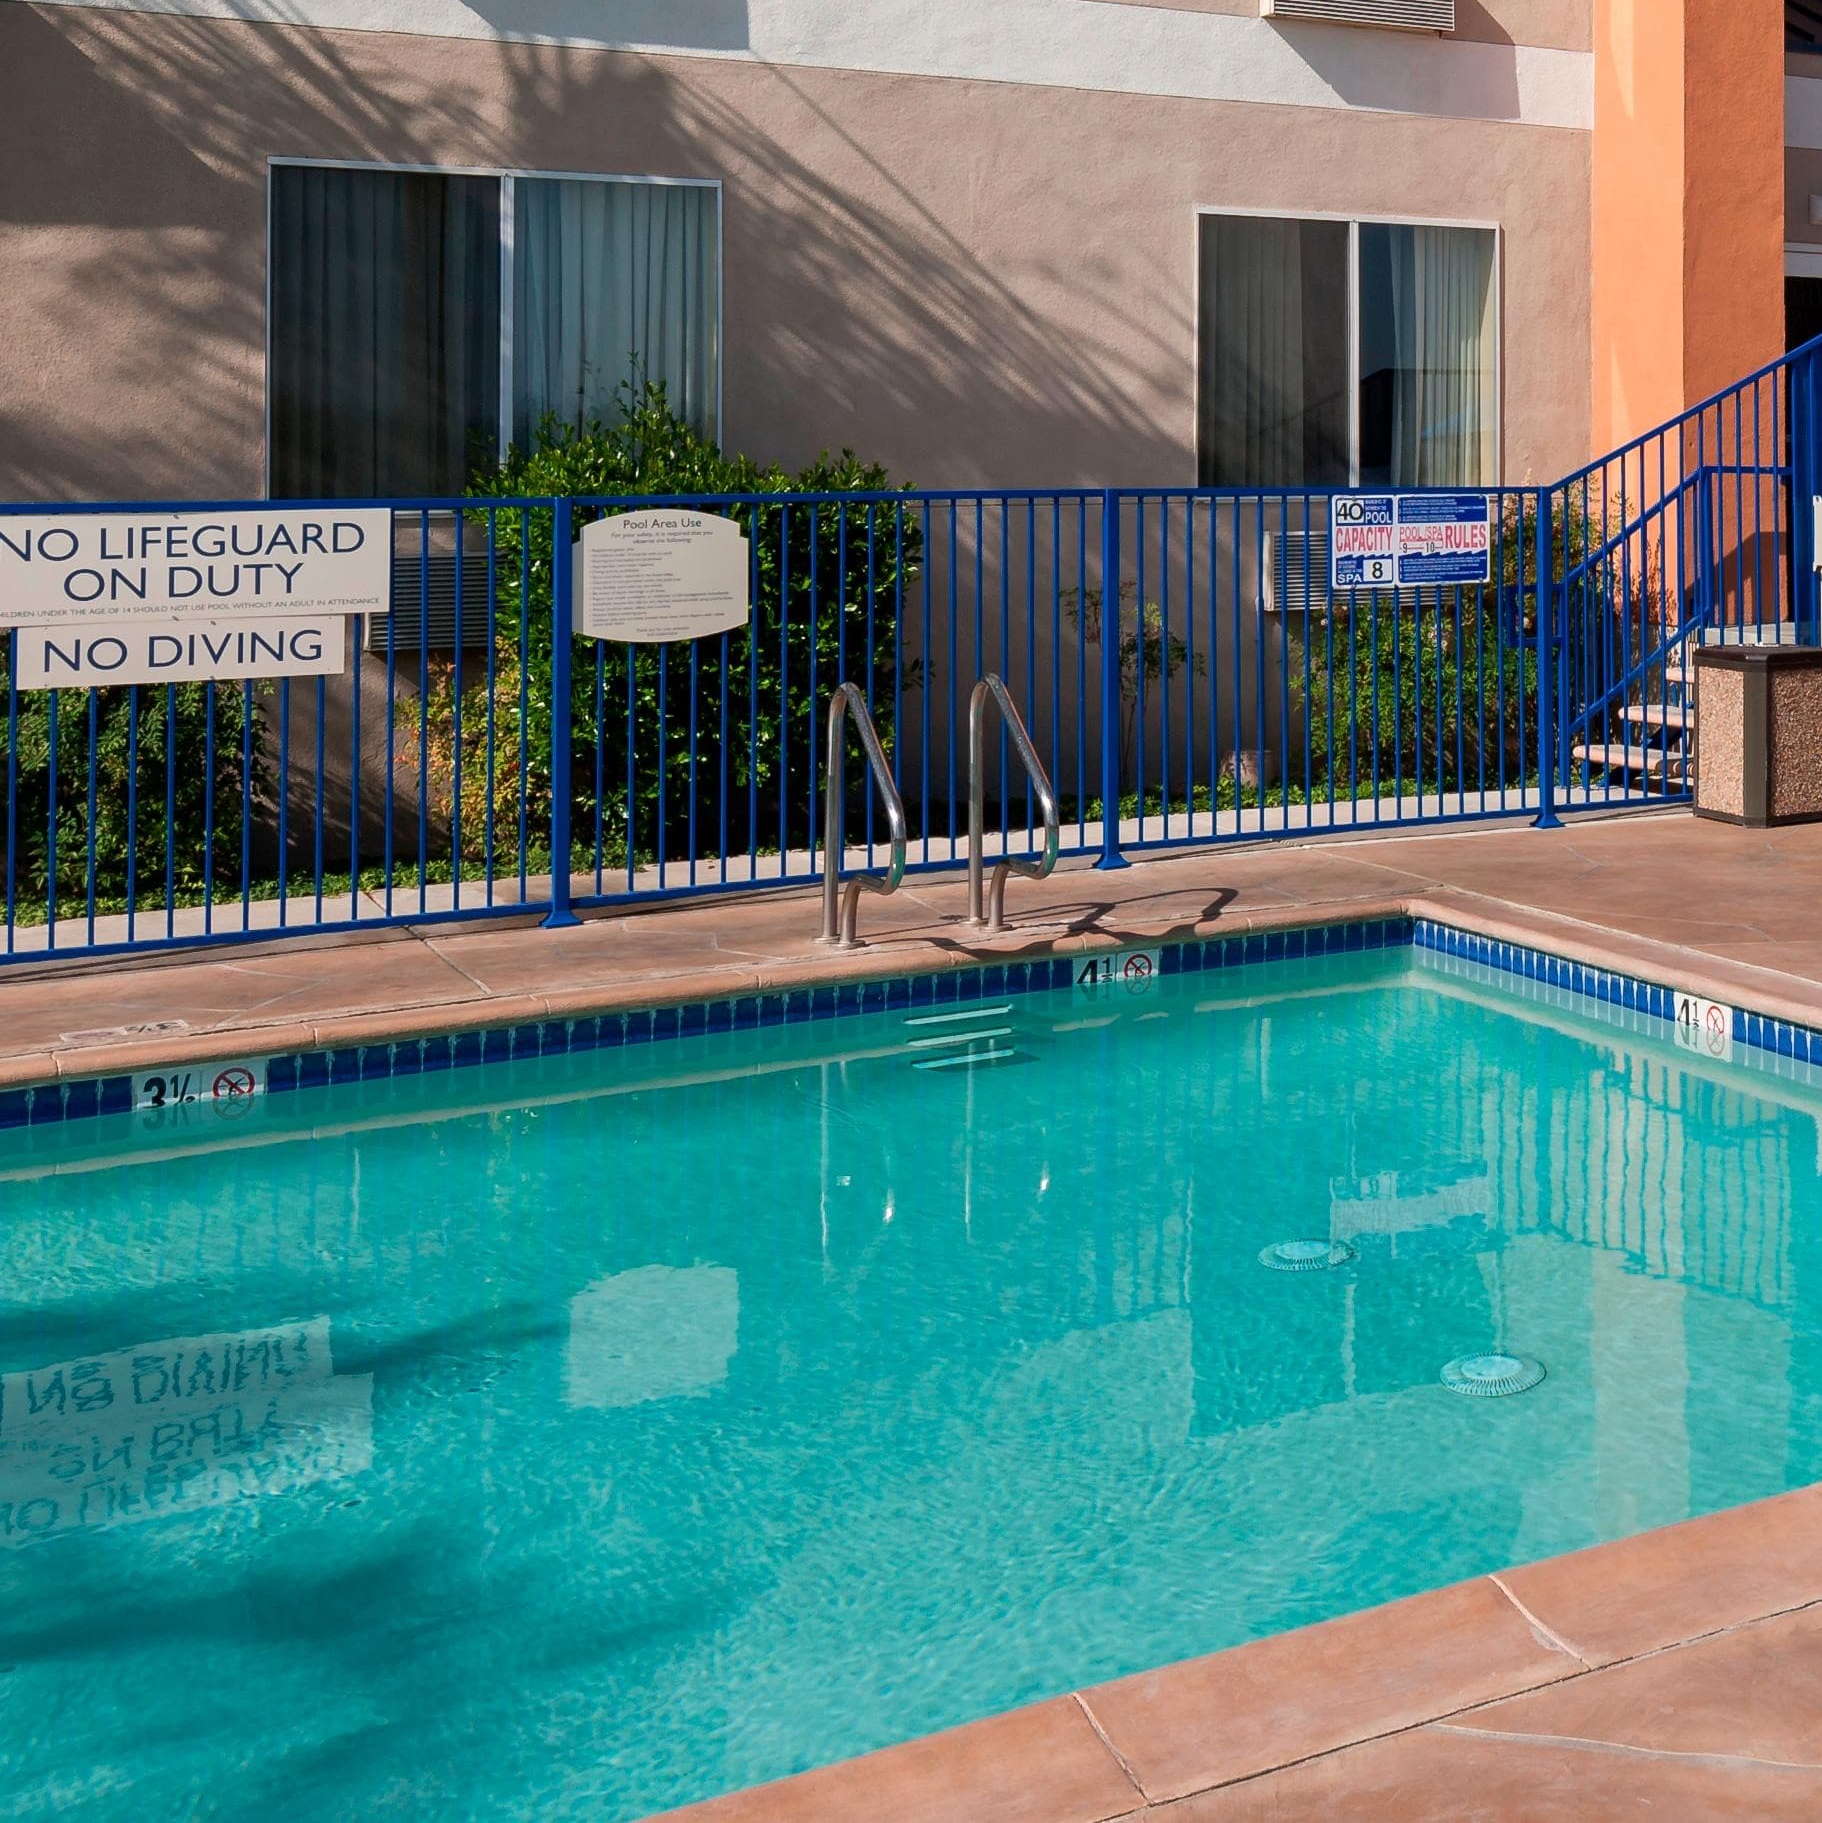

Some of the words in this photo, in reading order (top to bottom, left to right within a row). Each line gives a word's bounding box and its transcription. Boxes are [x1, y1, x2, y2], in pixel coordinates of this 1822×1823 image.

[1337, 502, 1364, 521] 40
[1365, 511, 1392, 524] POOL
[623, 519, 648, 529] Pool
[651, 518, 678, 528] Area
[681, 517, 702, 528] Use
[0, 528, 79, 562] NO
[100, 522, 365, 559] LIFEGUARD
[1336, 526, 1393, 552] CAPACITY
[1445, 524, 1486, 549] RULES
[1337, 573, 1362, 583] SPA
[1372, 562, 1383, 579] 8
[63, 567, 147, 601] ON
[168, 562, 304, 598] DUTY
[38, 609, 67, 618] UNDER
[71, 608, 87, 616] THE
[89, 607, 106, 615] AGE
[133, 605, 168, 613] SHOULD
[170, 604, 188, 612] NOT
[190, 603, 206, 611] USE
[207, 602, 230, 610] POOL
[233, 601, 272, 610] WITHOUT
[289, 599, 315, 608] ADULT
[328, 597, 380, 606] ATTENDANCE
[43, 636, 128, 672] NO
[148, 629, 322, 669] DIVING
